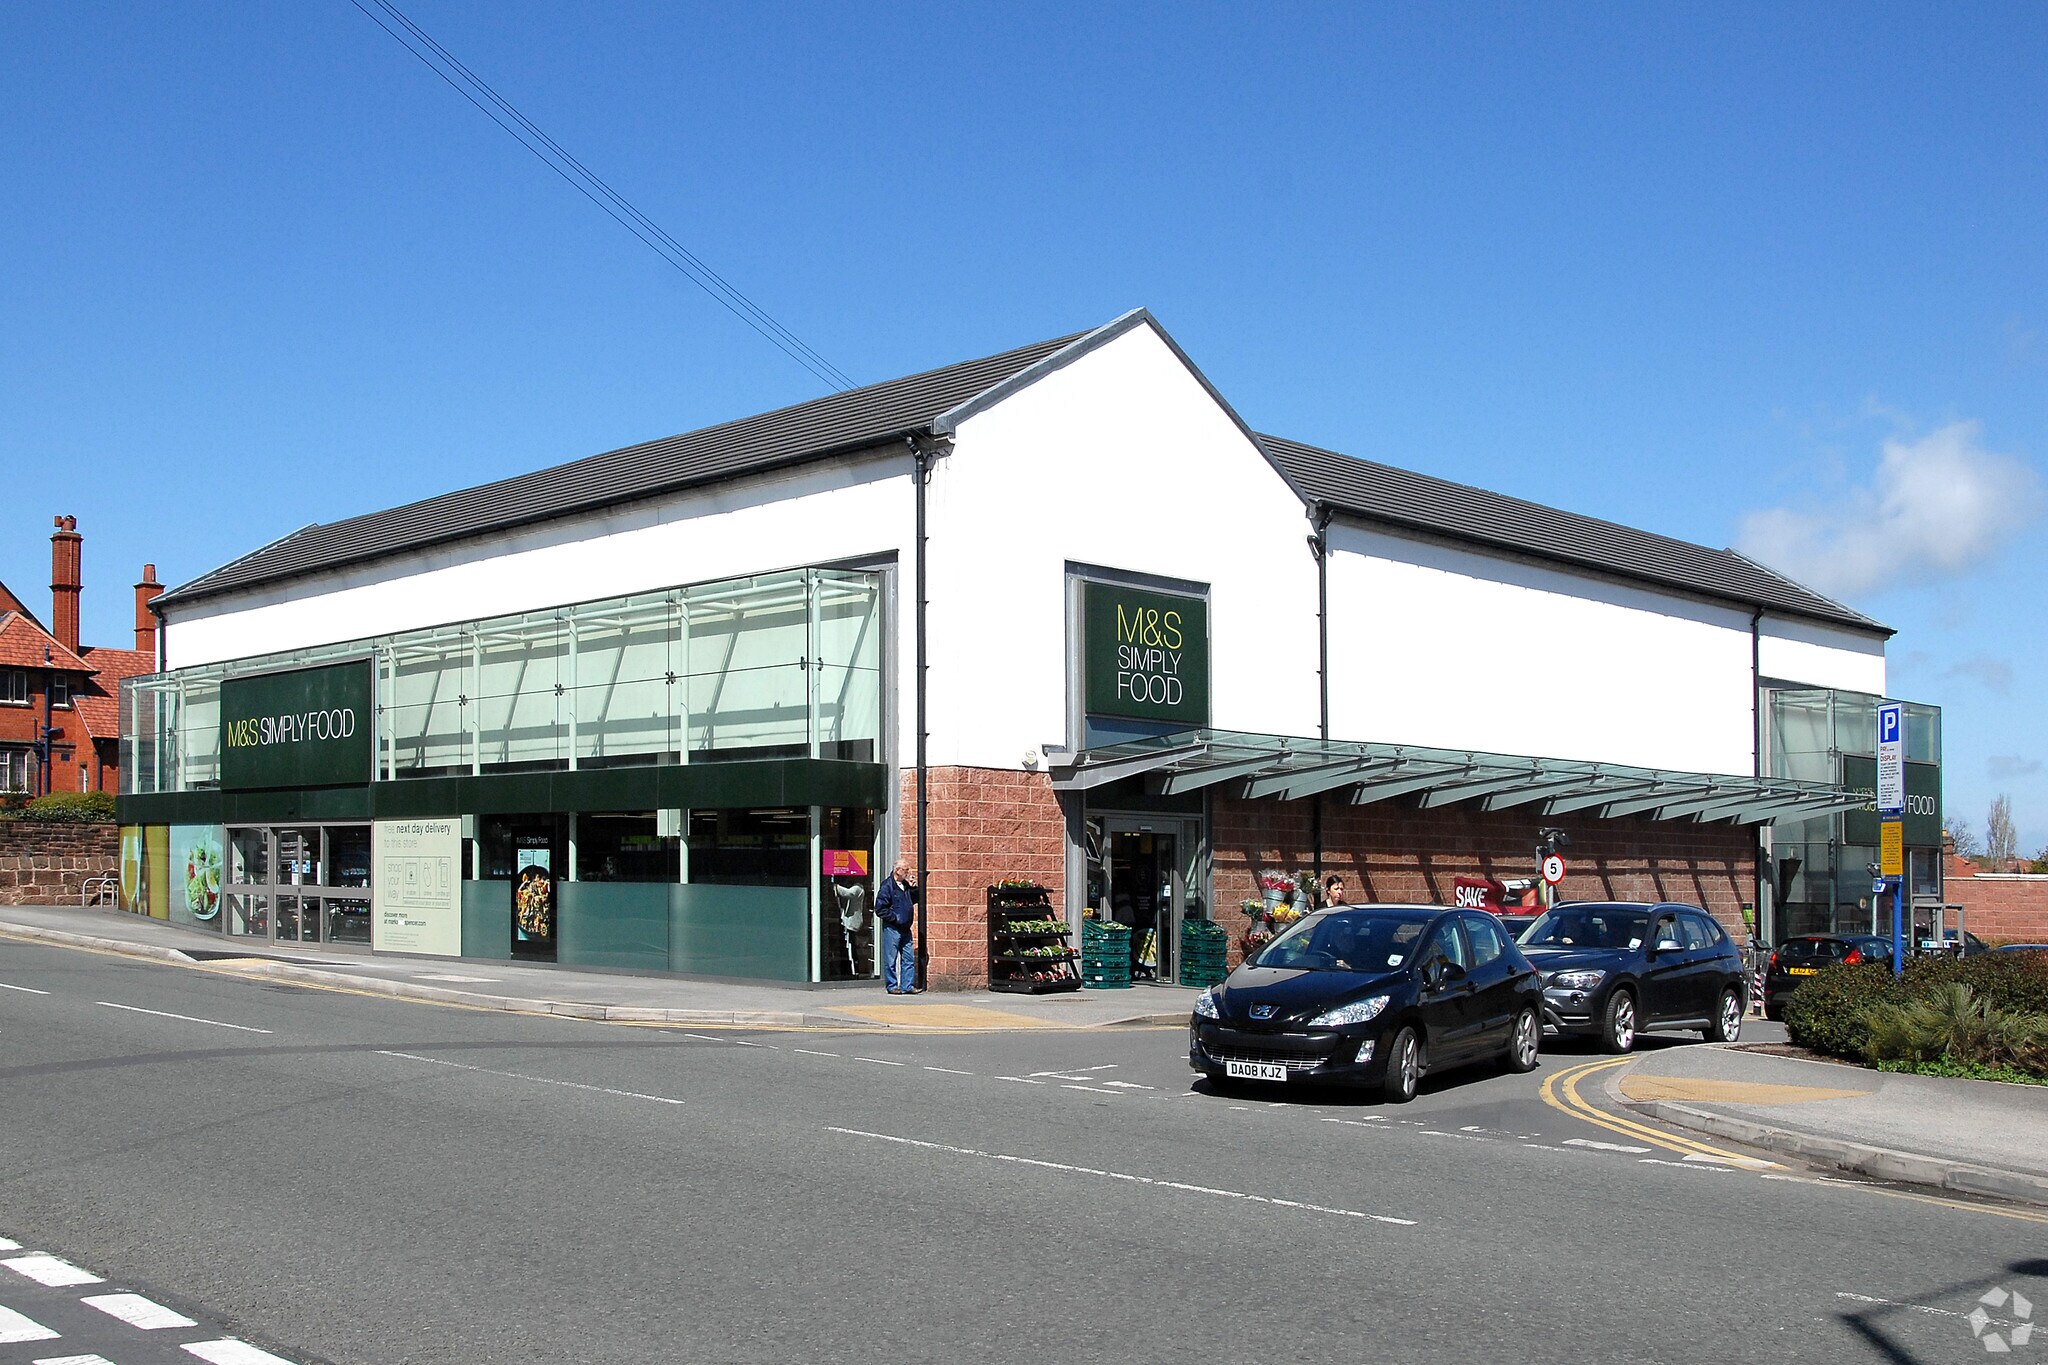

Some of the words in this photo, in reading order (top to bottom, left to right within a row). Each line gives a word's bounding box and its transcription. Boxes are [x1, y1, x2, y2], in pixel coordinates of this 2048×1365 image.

[1117, 603, 1182, 649] M&S
[1117, 645, 1182, 674] SIMPLY
[1117, 671, 1183, 705] FOOD
[228, 718, 258, 747] M&S
[1884, 711, 1896, 740] P
[1908, 794, 1935, 815] FOOD
[396, 824, 410, 834] next
[411, 823, 424, 836] day
[425, 822, 451, 836] delivery
[1550, 862, 1557, 875] 5
[1455, 886, 1488, 908] SAVE
[1231, 1063, 1258, 1076] DA08
[1261, 1066, 1282, 1079] KJZ
